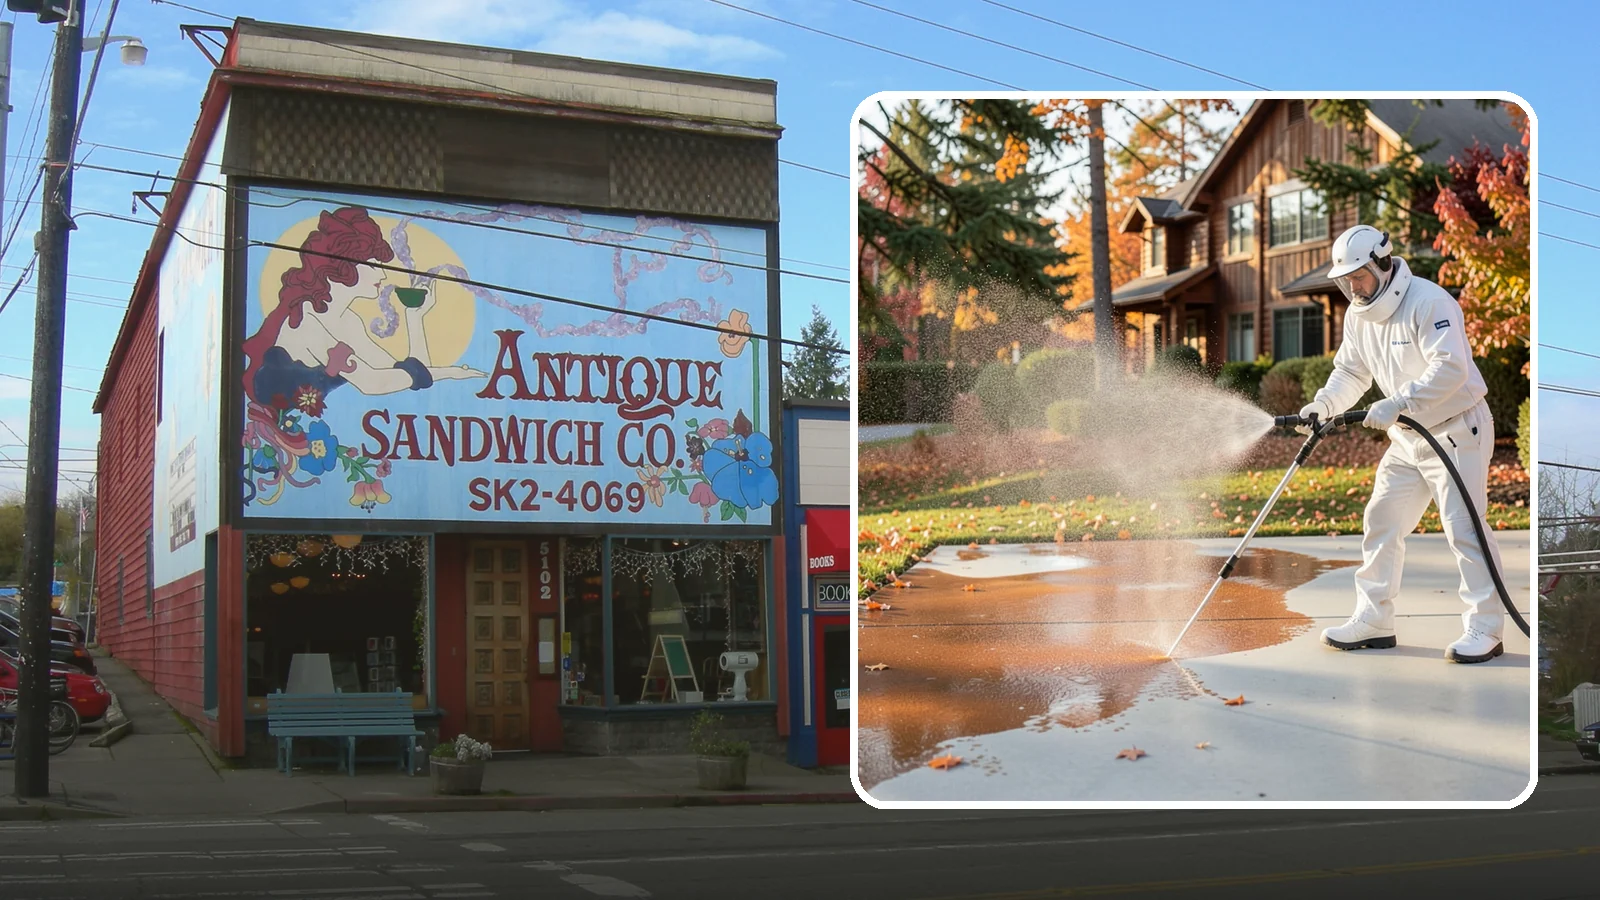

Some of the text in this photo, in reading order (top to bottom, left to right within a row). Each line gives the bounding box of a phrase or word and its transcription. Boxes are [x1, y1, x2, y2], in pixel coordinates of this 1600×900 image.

[477, 329, 723, 420] ANTIQUE
[362, 409, 684, 469] SANDWICH CO.
[468, 477, 645, 513] SK2-4069
[540, 542, 551, 599] 5102
[809, 555, 834, 569] BOOKS
